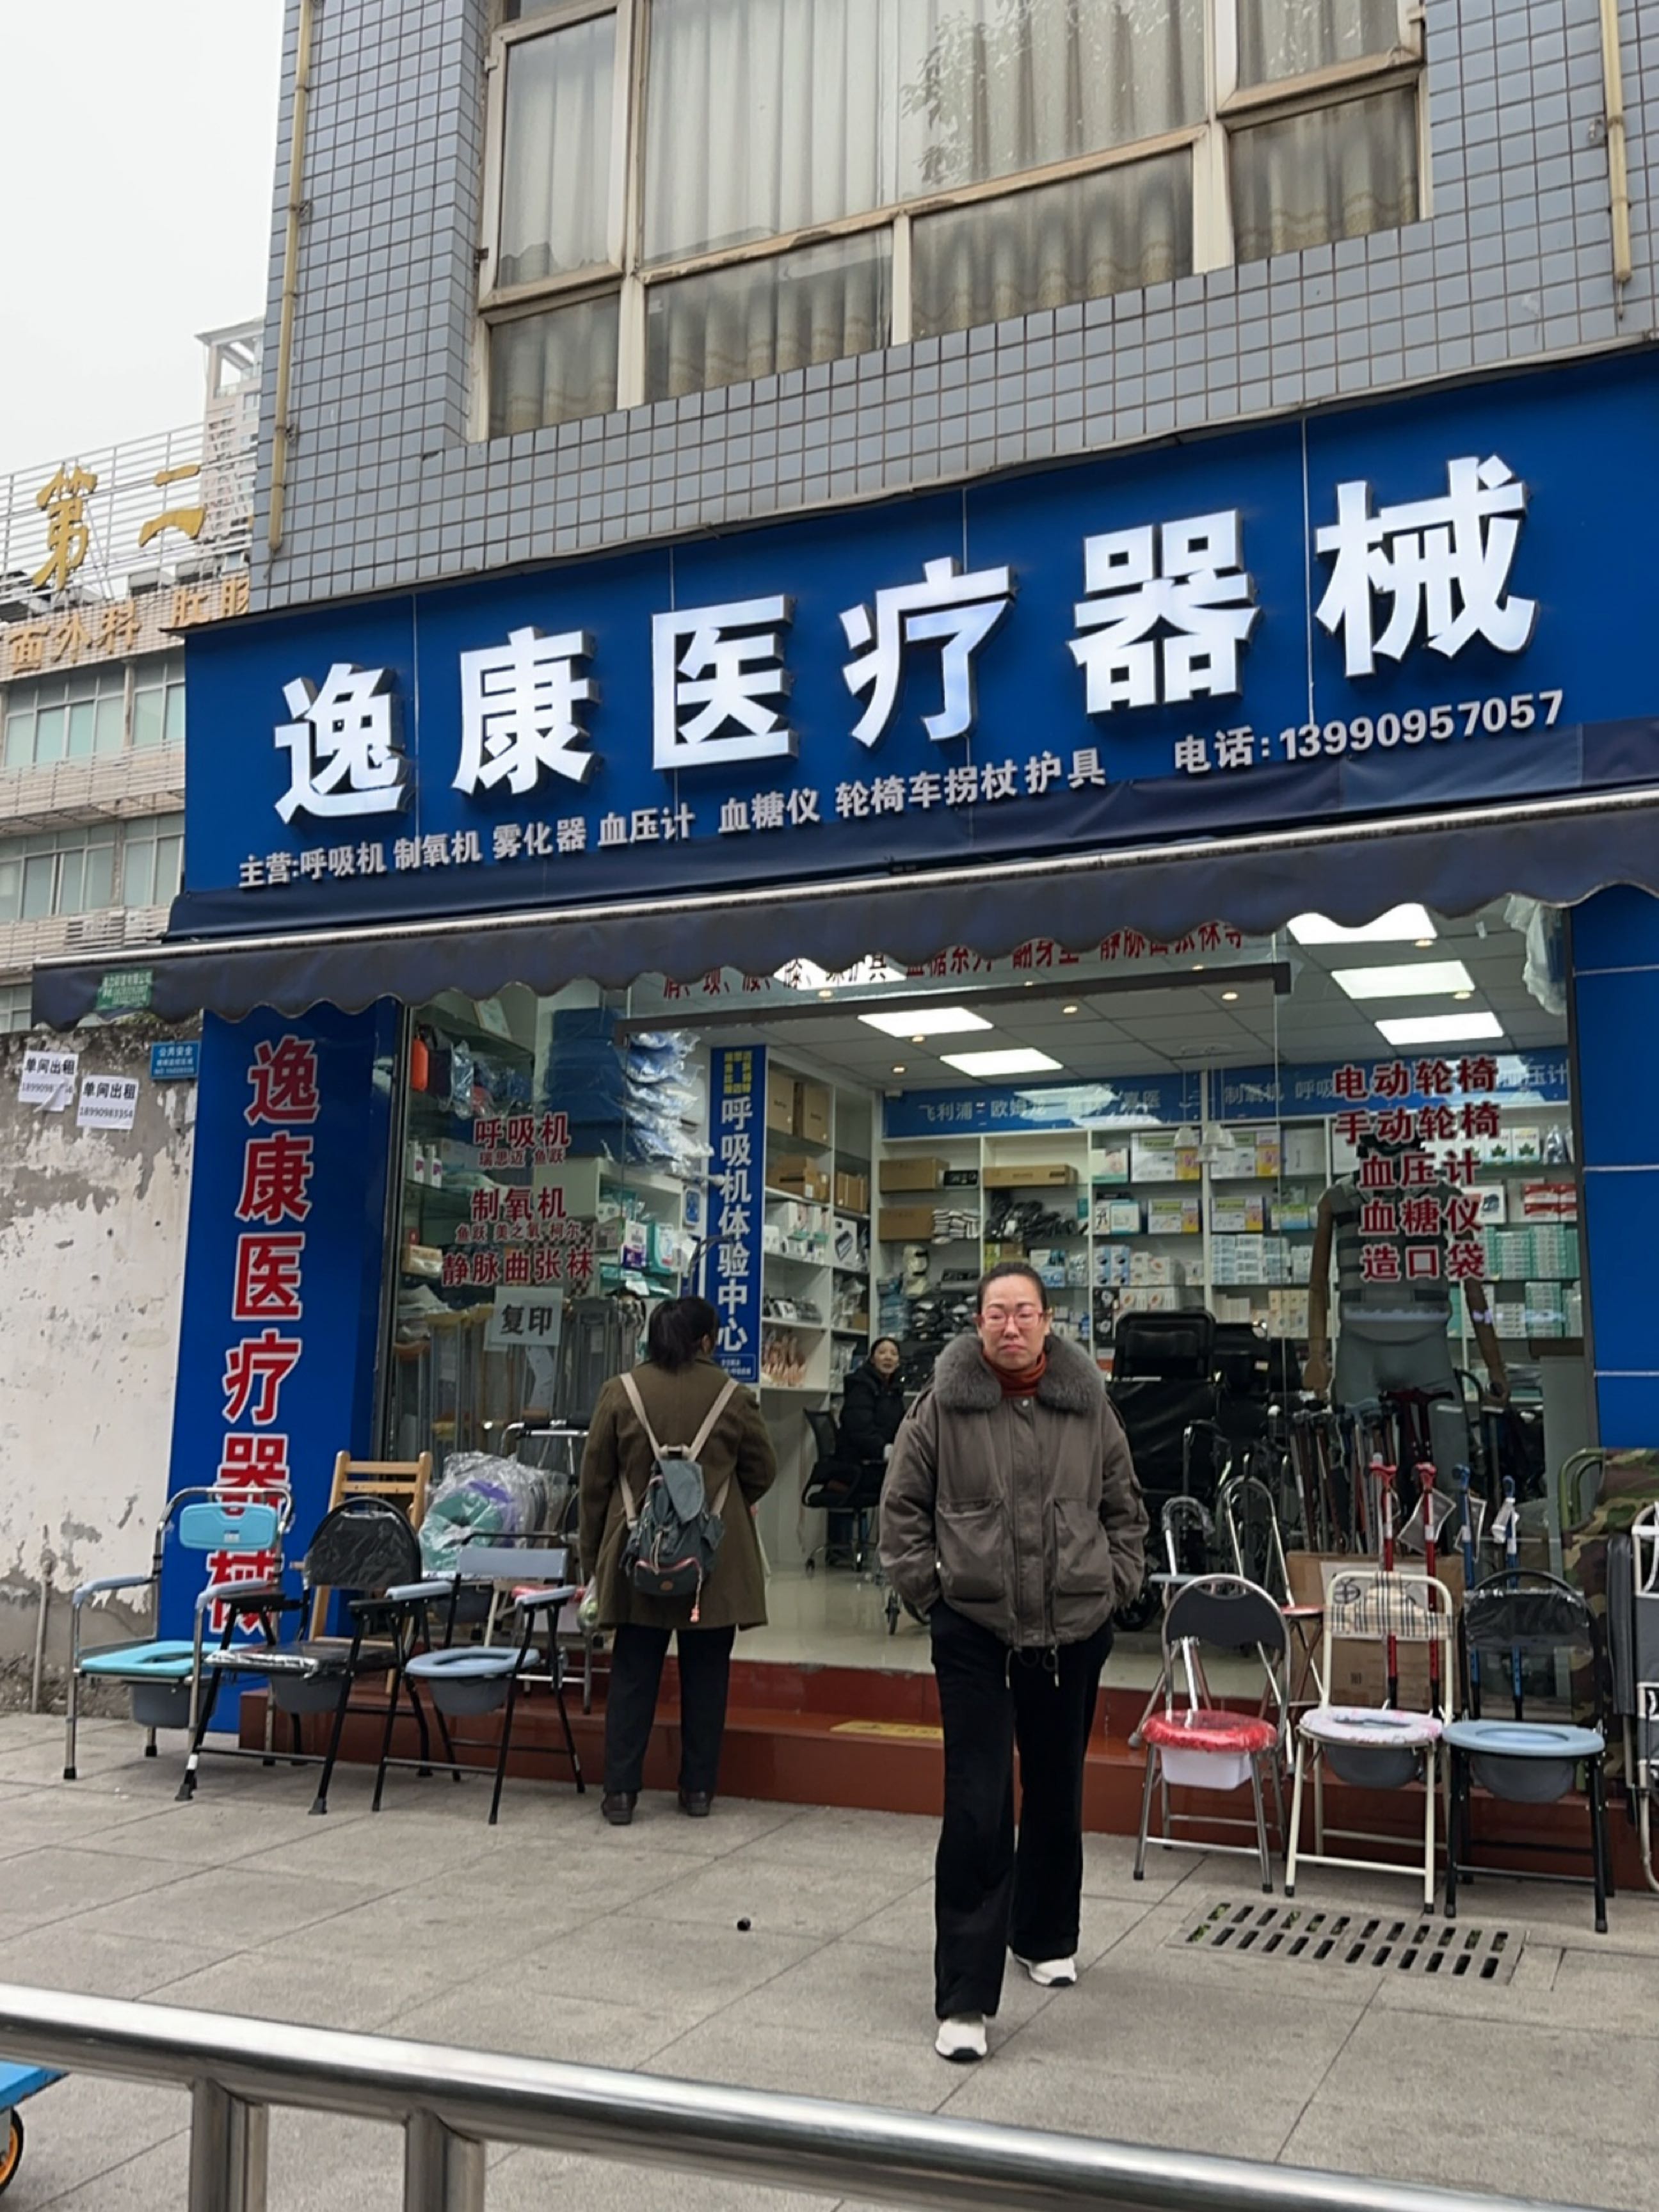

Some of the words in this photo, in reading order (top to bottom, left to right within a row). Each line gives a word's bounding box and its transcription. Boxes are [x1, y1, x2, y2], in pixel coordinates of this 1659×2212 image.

[32, 465, 206, 590] 第二
[275, 454, 1537, 824] 逸康医疗器械
[394, 831, 482, 871] 制氧机
[492, 816, 586, 860] 雾化器
[598, 803, 696, 847] 血压计
[718, 788, 820, 833] 血糖仪
[835, 747, 1106, 819] 轮椅车拐杖护具
[24, 1057, 75, 1075] 单间出租
[1333, 1054, 1500, 1101] 电动轮椅
[83, 1082, 136, 1100] 单间出租
[918, 1101, 973, 1121] 飞利浦
[474, 1111, 571, 1150] 呼吸机
[1334, 1102, 1500, 1146] 手动轮椅
[1358, 1150, 1482, 1191] 血压计
[470, 1185, 567, 1222] 制氧机
[716, 1094, 753, 1352] 呼吸机体验中心
[1359, 1196, 1484, 1237] 血糖仪
[442, 1246, 594, 1286] 静脉曲张袜
[1360, 1242, 1487, 1283] 造口袋
[501, 1304, 553, 1336] 复印
